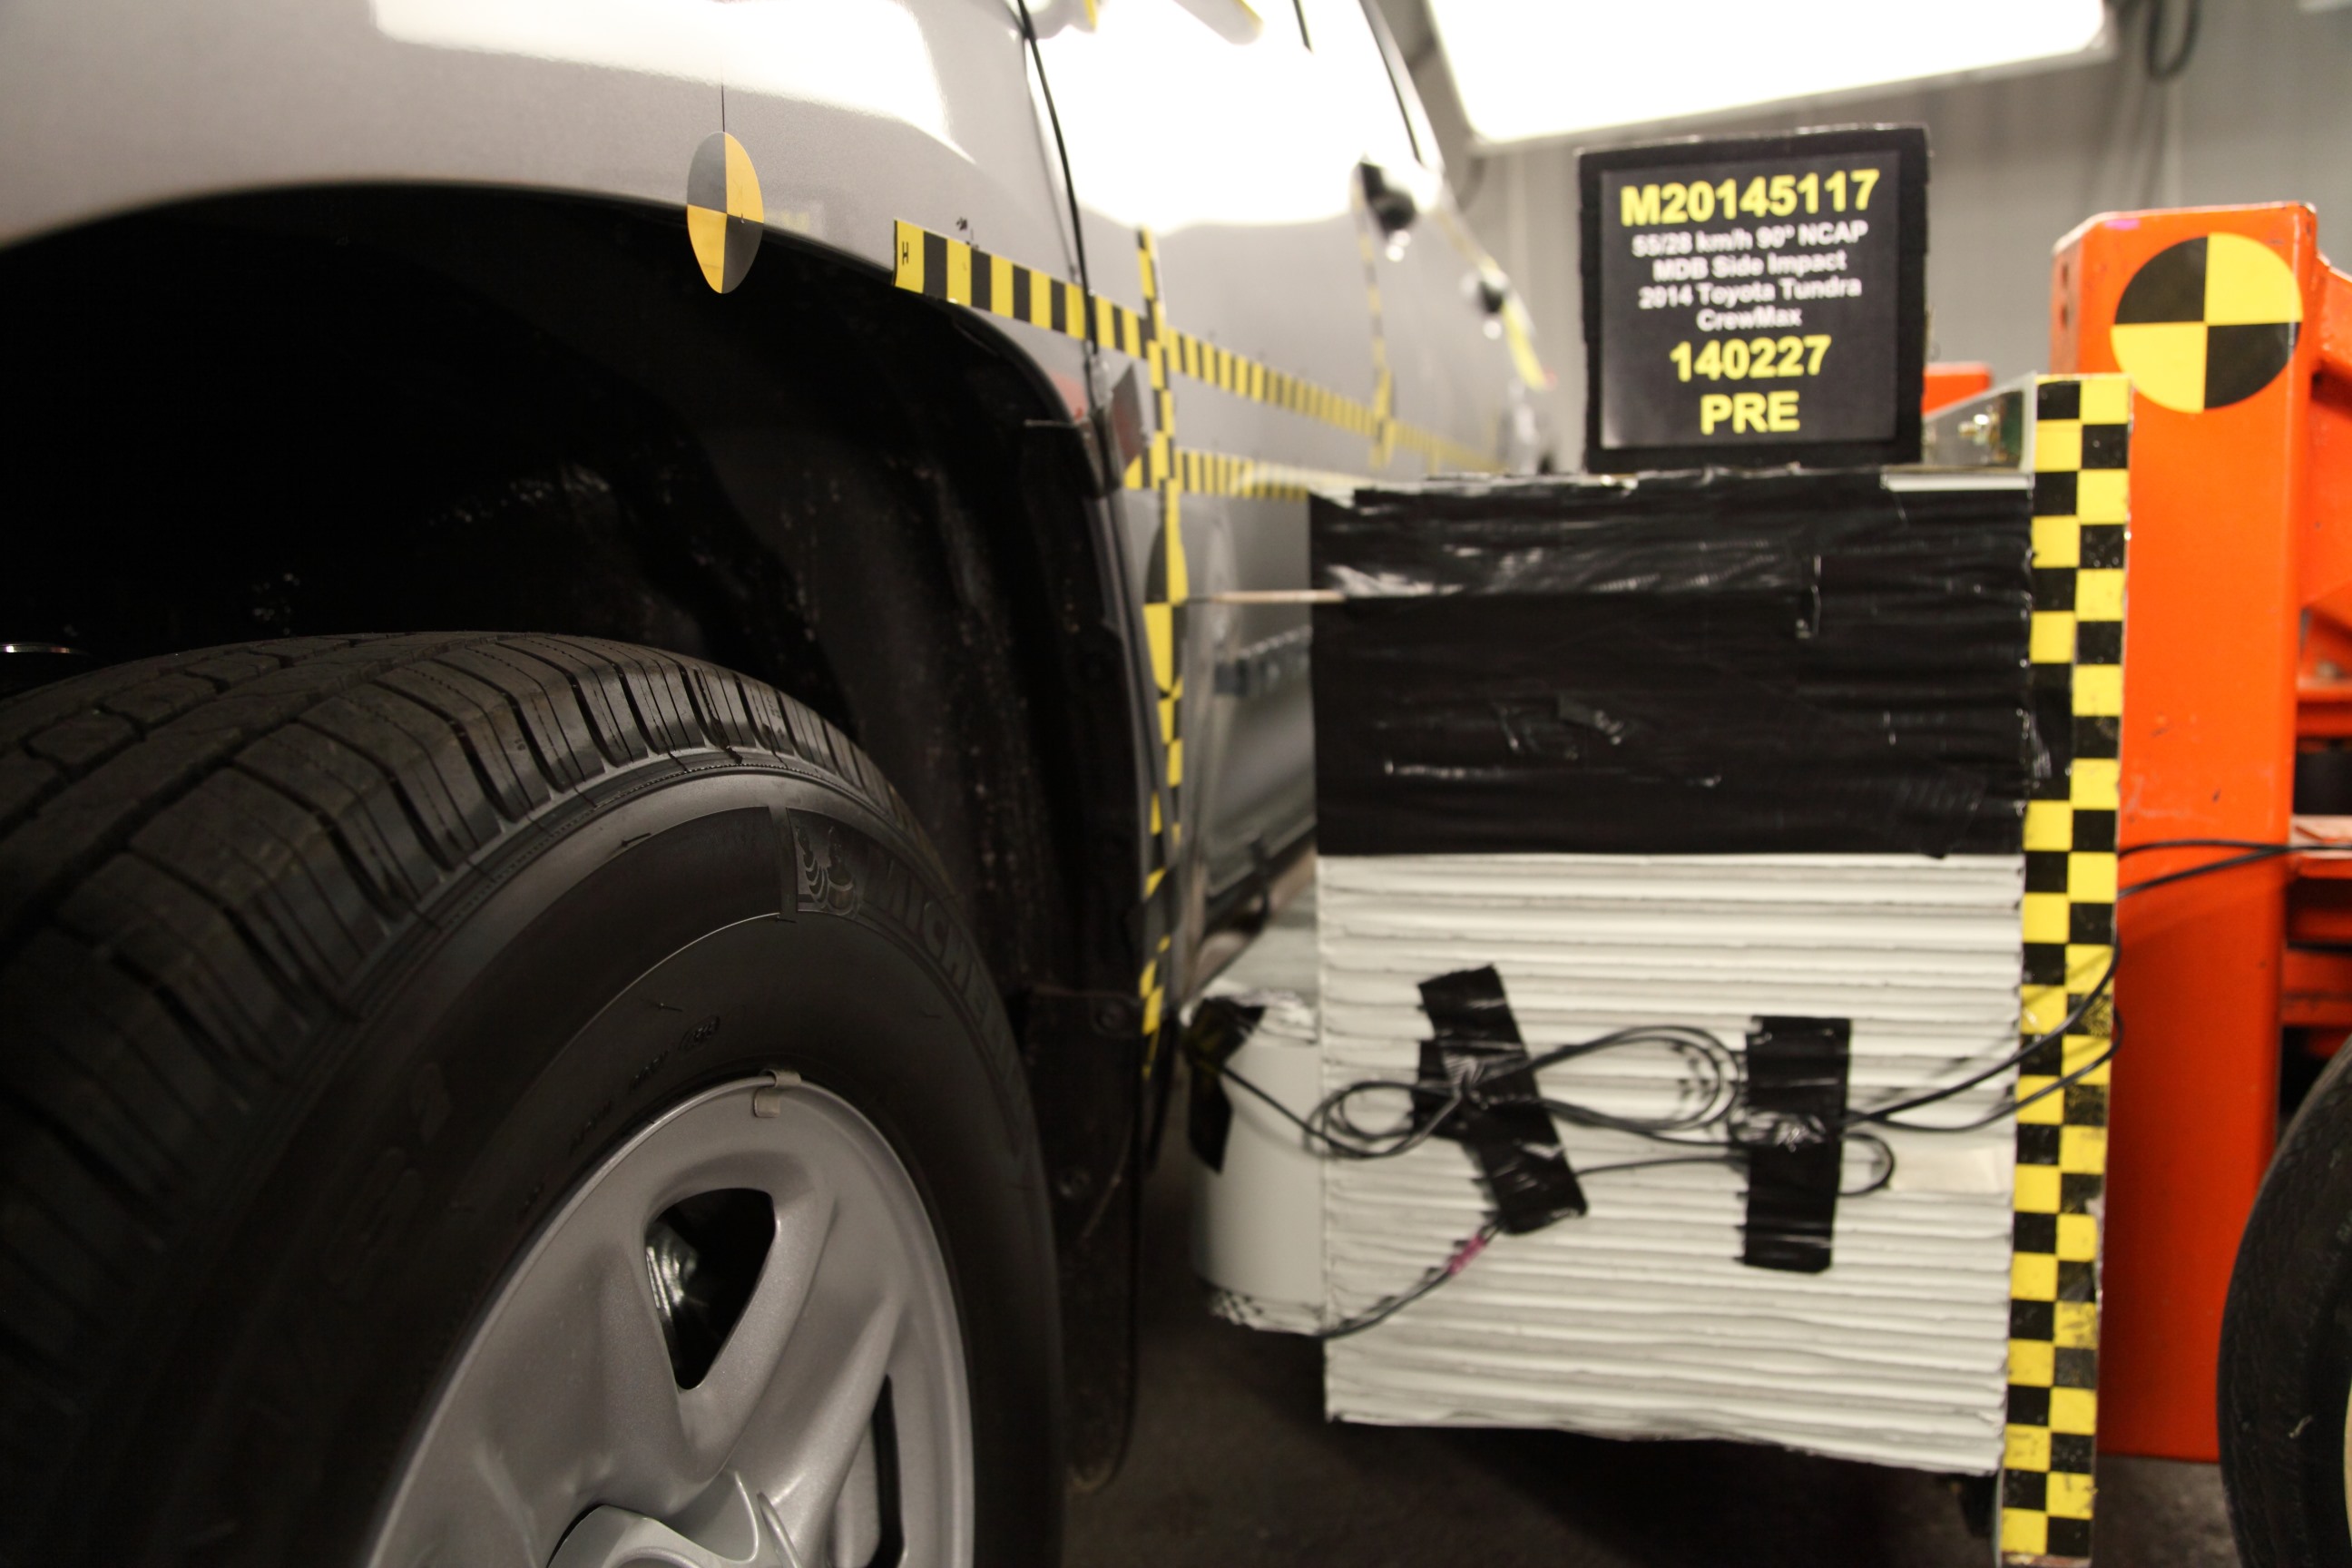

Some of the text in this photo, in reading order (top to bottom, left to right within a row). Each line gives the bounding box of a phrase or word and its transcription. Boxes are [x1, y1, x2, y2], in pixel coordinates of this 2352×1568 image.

[1621, 169, 1880, 226] M20145117
[1798, 220, 1868, 246] NCAP
[1652, 250, 1847, 281] MDB Side Impact
[1639, 276, 1862, 309] 2014 Toyota Tundra
[1696, 306, 1802, 331] CrewMax
[1670, 335, 1831, 382] 140227
[1700, 390, 1800, 436] PRE
